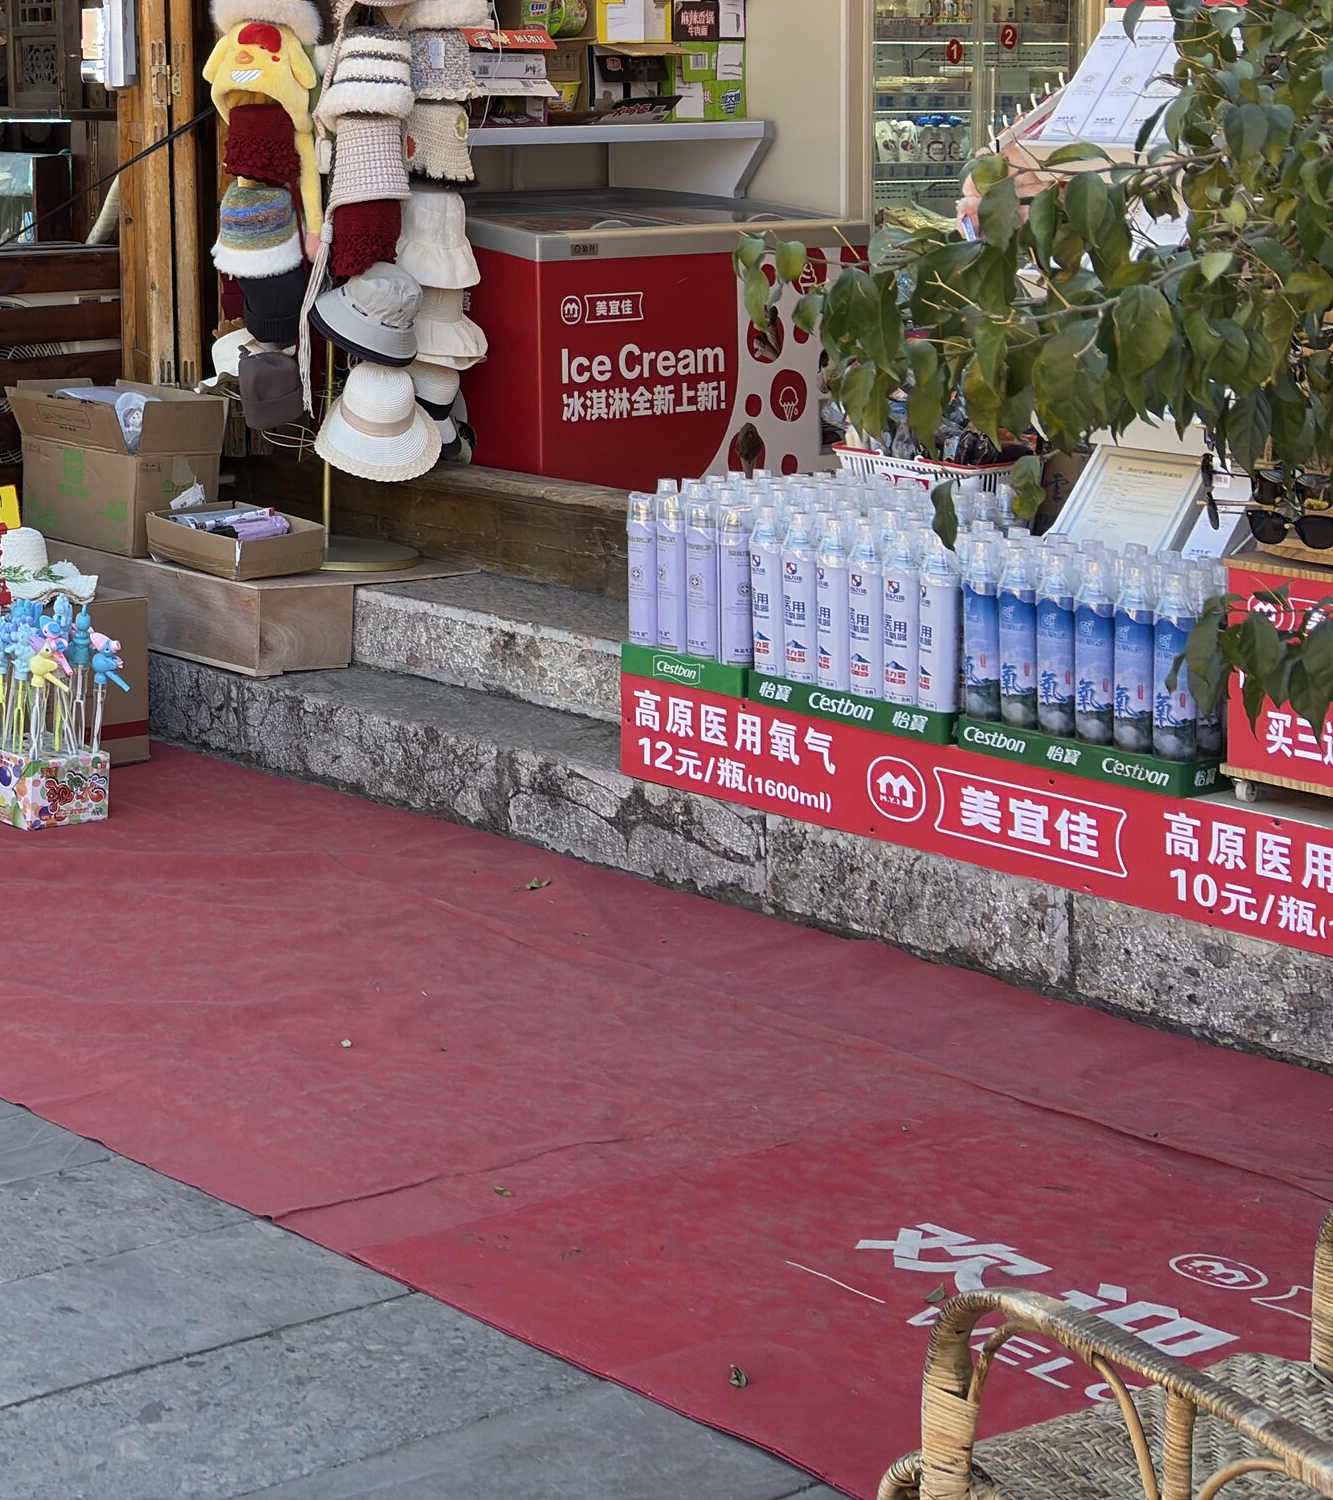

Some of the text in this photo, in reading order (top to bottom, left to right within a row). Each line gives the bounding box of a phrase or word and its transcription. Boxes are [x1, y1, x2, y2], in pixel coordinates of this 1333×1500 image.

[680, 10, 715, 25] 麻辣香锅
[687, 25, 709, 37] 牛肉面
[1004, 29, 1014, 45] 2
[594, 299, 634, 317] 美宜佳
[561, 342, 726, 385] Ice Cream
[561, 380, 727, 423] 冰淇淋全新上新!
[655, 660, 698, 682] C'estbon
[808, 690, 875, 723] C'estbon
[632, 688, 837, 776] 高原医用氧气
[962, 725, 1027, 755] C'estbon
[1100, 756, 1171, 788] C'estbon
[959, 785, 1100, 859] 美宜佳
[1169, 867, 1333, 939] 10元/瓶(
